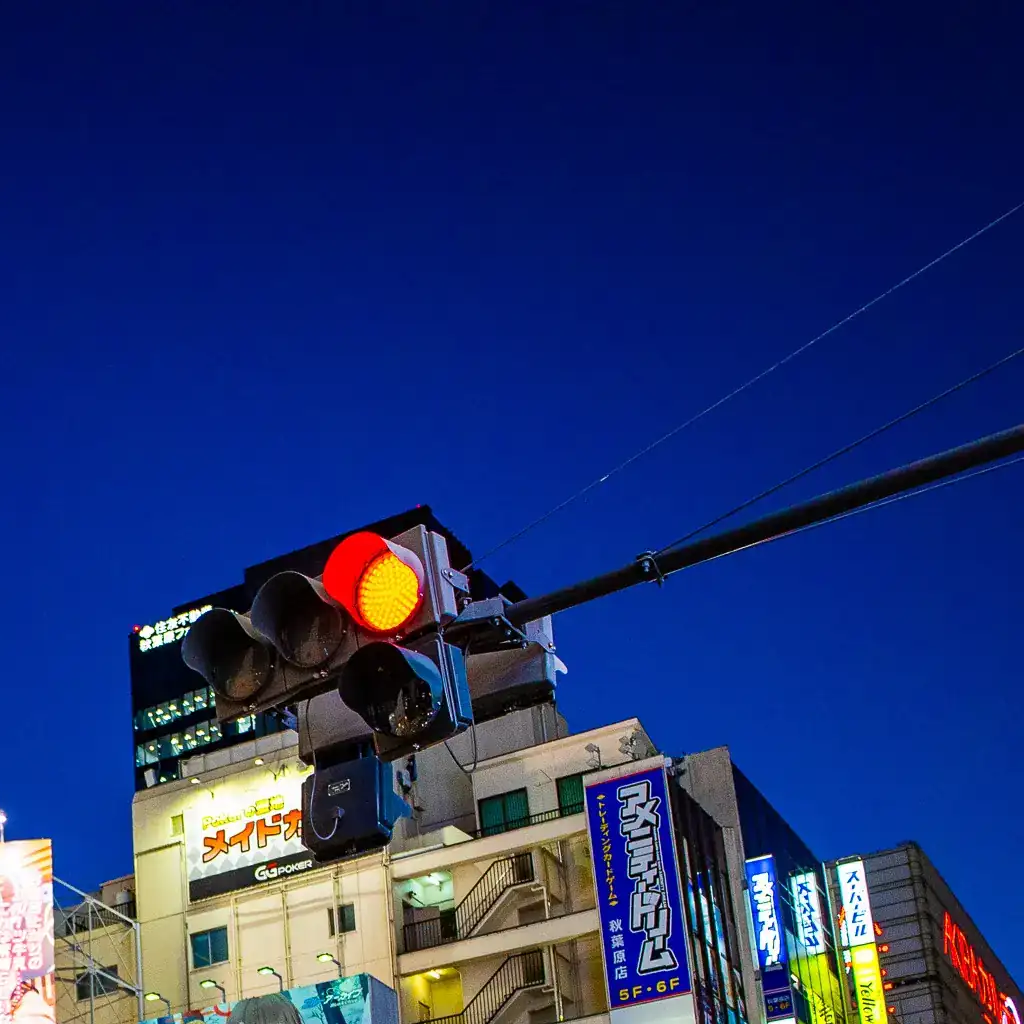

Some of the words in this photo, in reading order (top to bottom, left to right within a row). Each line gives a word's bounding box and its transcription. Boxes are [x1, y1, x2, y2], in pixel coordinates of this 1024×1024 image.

[845, 870, 868, 937] スーパービル
[608, 918, 629, 980] 秋葉原店
[859, 981, 876, 1024] Yellow
